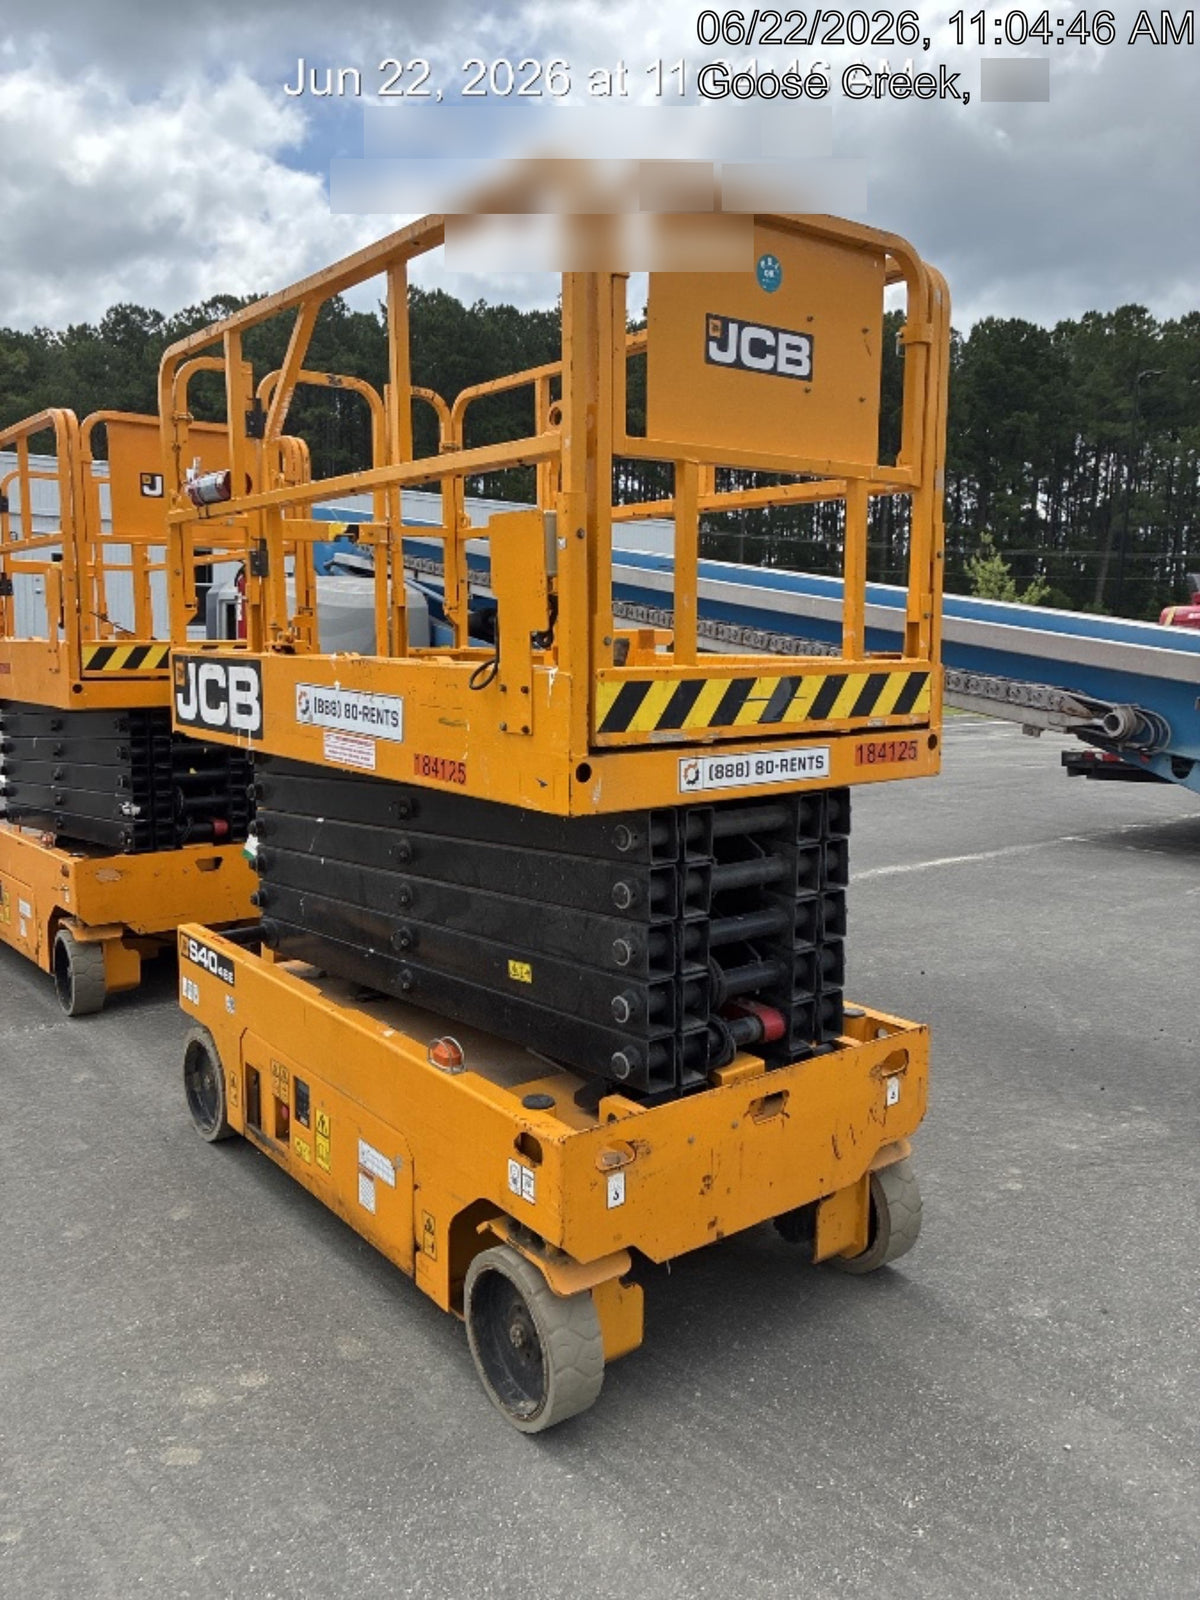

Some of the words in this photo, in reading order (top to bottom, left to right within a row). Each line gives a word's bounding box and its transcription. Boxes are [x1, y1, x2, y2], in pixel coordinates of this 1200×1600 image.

[708, 322, 811, 376] JCB
[175, 662, 262, 732] JCB
[708, 758, 750, 781] (888)
[754, 755, 825, 775] 80-RENTS
[856, 740, 919, 765] 184125
[413, 753, 467, 786] 184125
